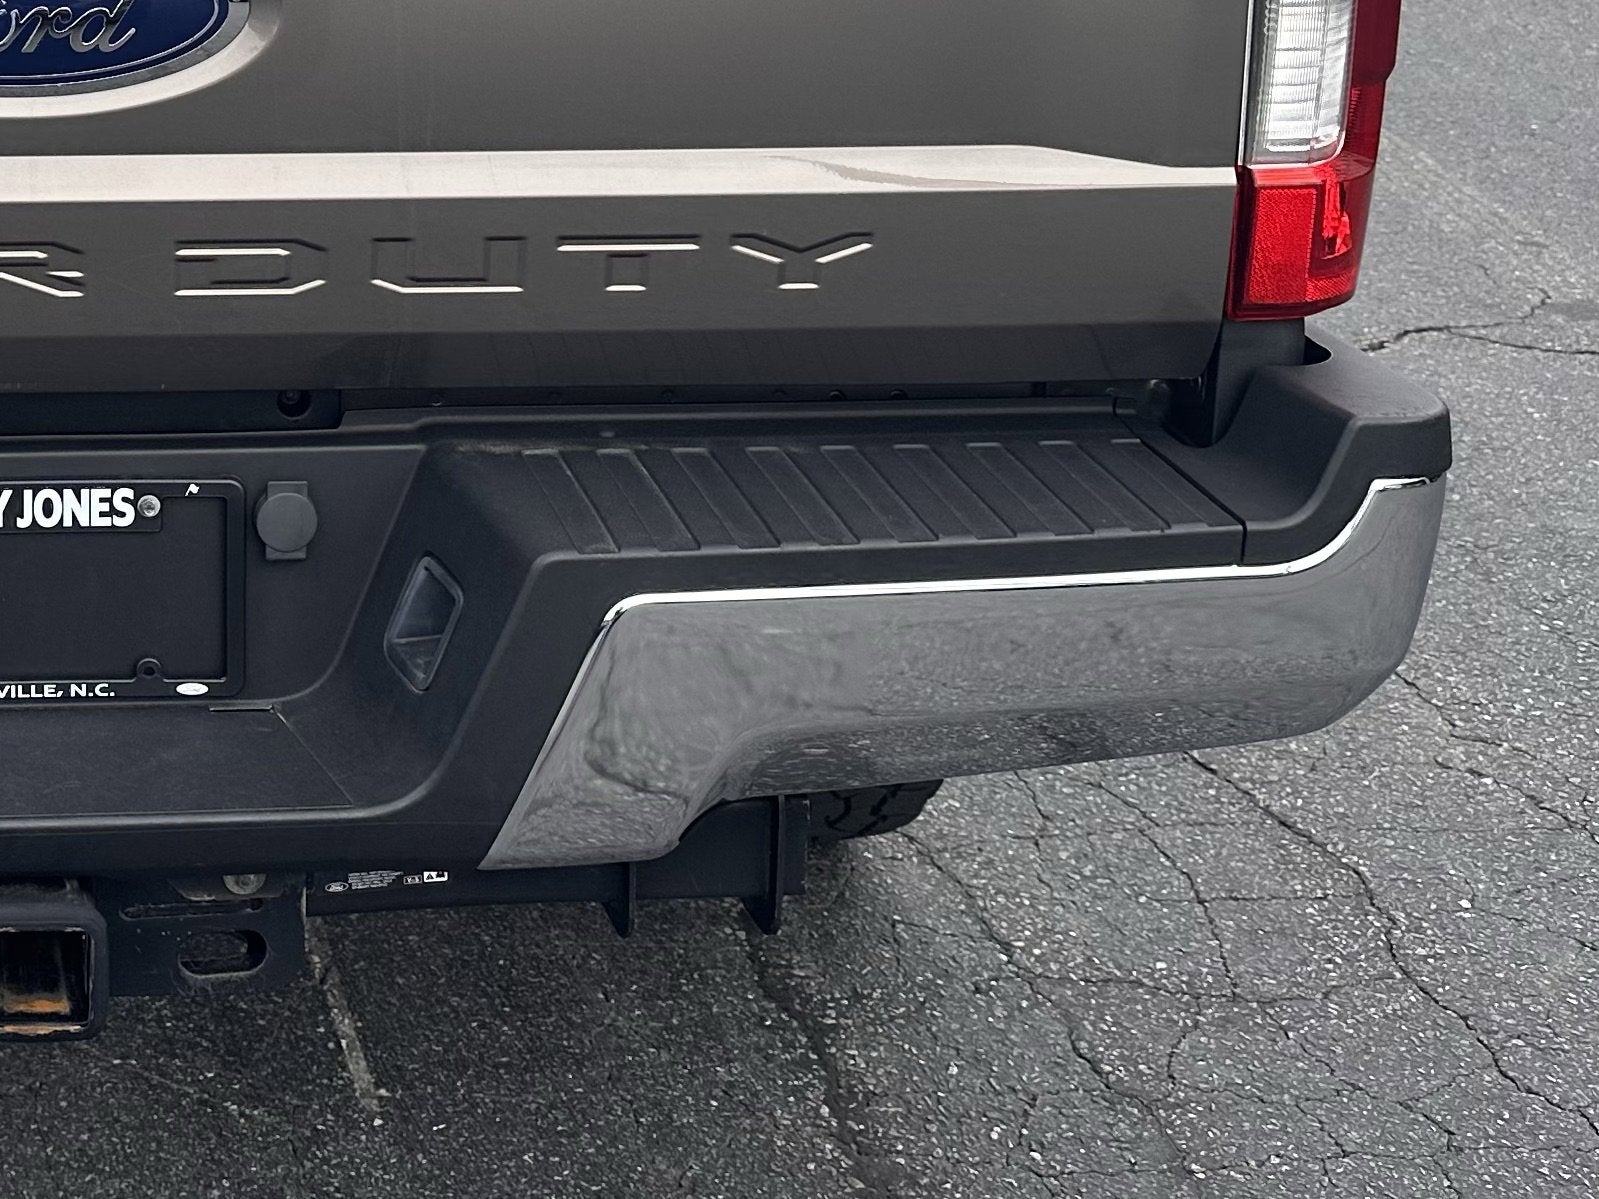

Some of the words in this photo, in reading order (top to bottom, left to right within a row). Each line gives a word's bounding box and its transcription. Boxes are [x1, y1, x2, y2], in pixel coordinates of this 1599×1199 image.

[174, 231, 874, 297] DUTY
[16, 487, 137, 529] JONES
[70, 682, 116, 698] N.C.
